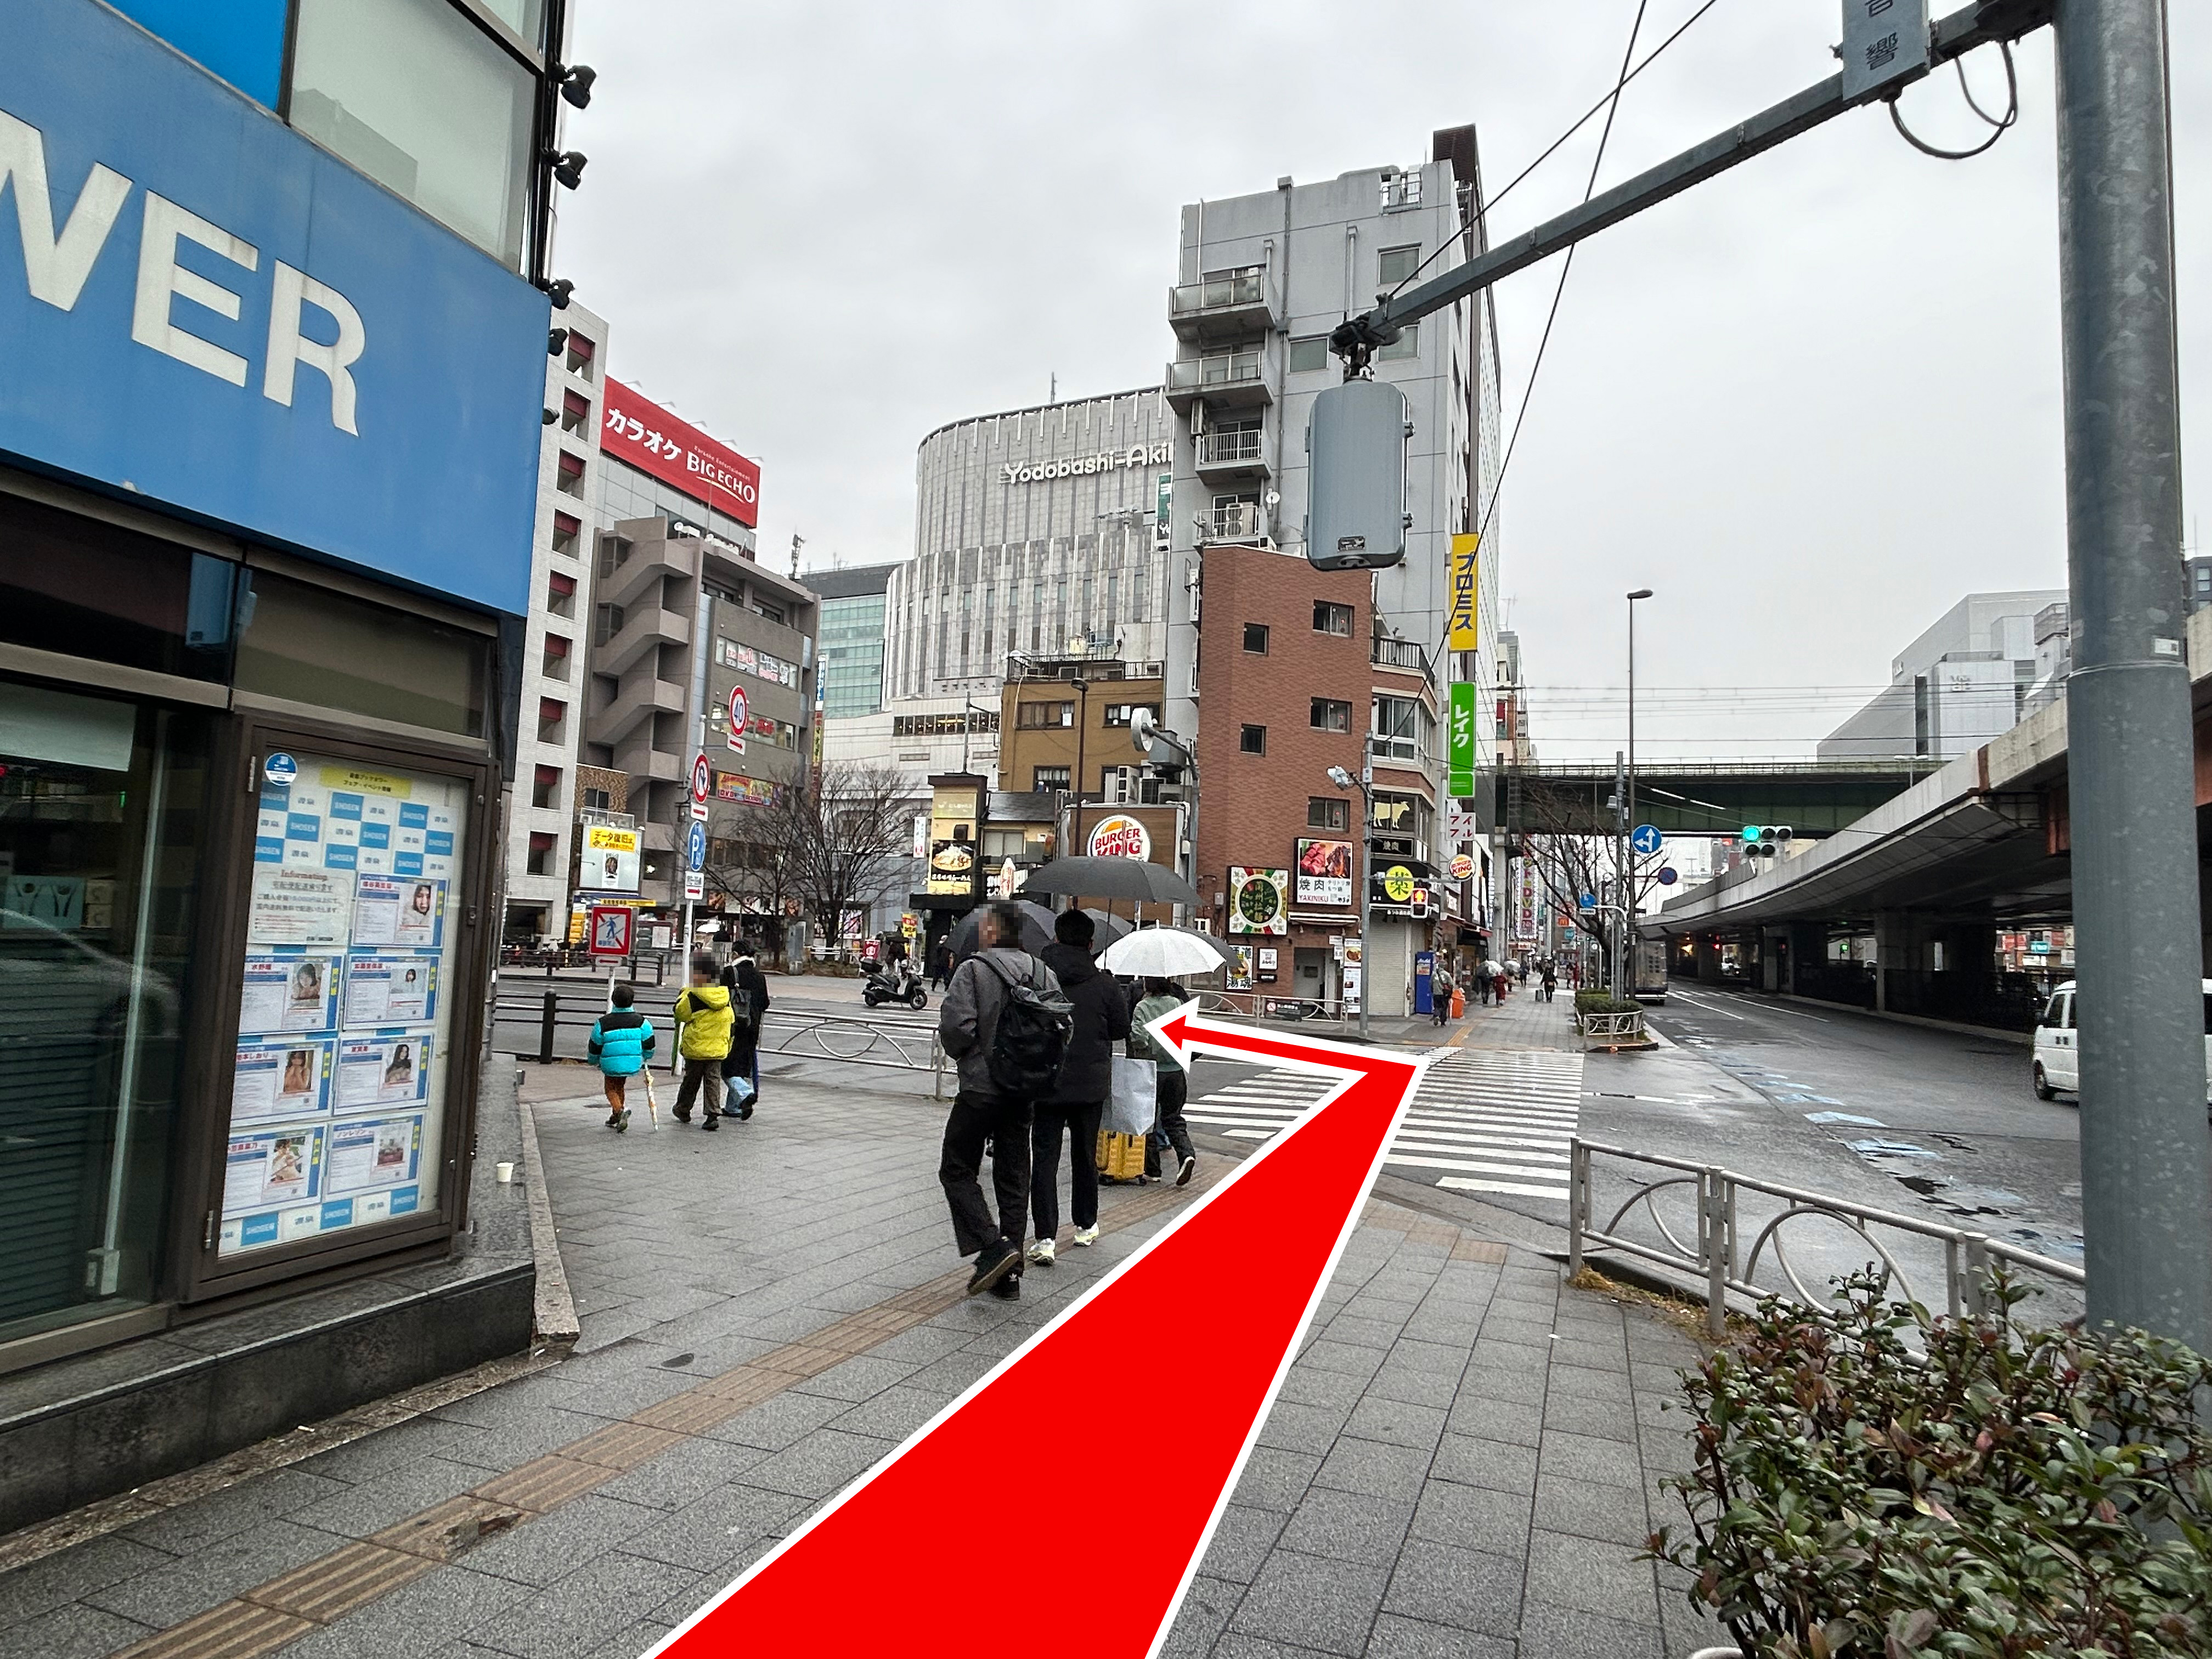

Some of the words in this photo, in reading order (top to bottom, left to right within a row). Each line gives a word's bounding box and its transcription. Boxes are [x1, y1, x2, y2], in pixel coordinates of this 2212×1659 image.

[605, 408, 682, 460] カラオケ
[686, 450, 715, 478] BIG
[717, 470, 756, 504] ECHO
[1455, 551, 1475, 631] プロミス
[733, 700, 744, 723] 40
[1453, 704, 1470, 748] レイク
[691, 834, 699, 865] P
[1095, 828, 1141, 850] BURGER
[1383, 840, 1399, 850] 焼肉
[1452, 865, 1472, 874] KING
[1299, 878, 1325, 891] 焼肉
[1299, 894, 1329, 902] YAKINIKU
